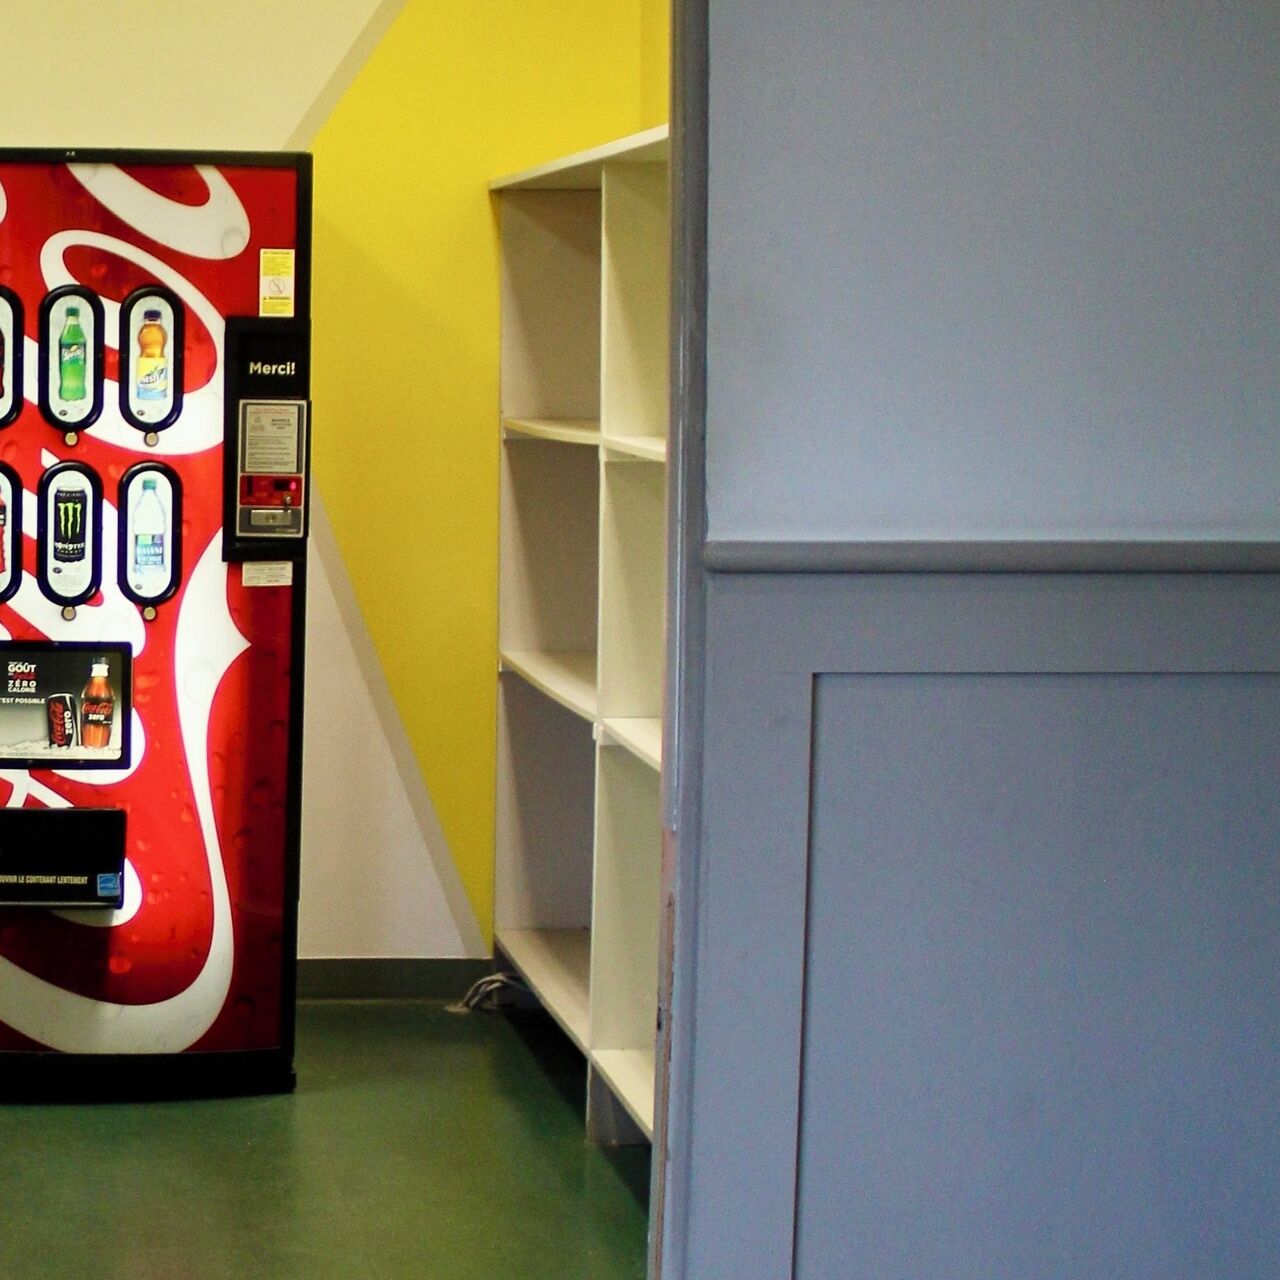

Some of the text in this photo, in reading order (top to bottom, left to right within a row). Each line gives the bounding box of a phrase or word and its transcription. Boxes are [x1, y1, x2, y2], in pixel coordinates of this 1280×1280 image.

[249, 361, 296, 375] Merci!
[8, 663, 36, 673] GOÛT
[8, 679, 36, 688] ZÉRO
[88, 713, 105, 721] zero
[63, 710, 73, 735] zero
